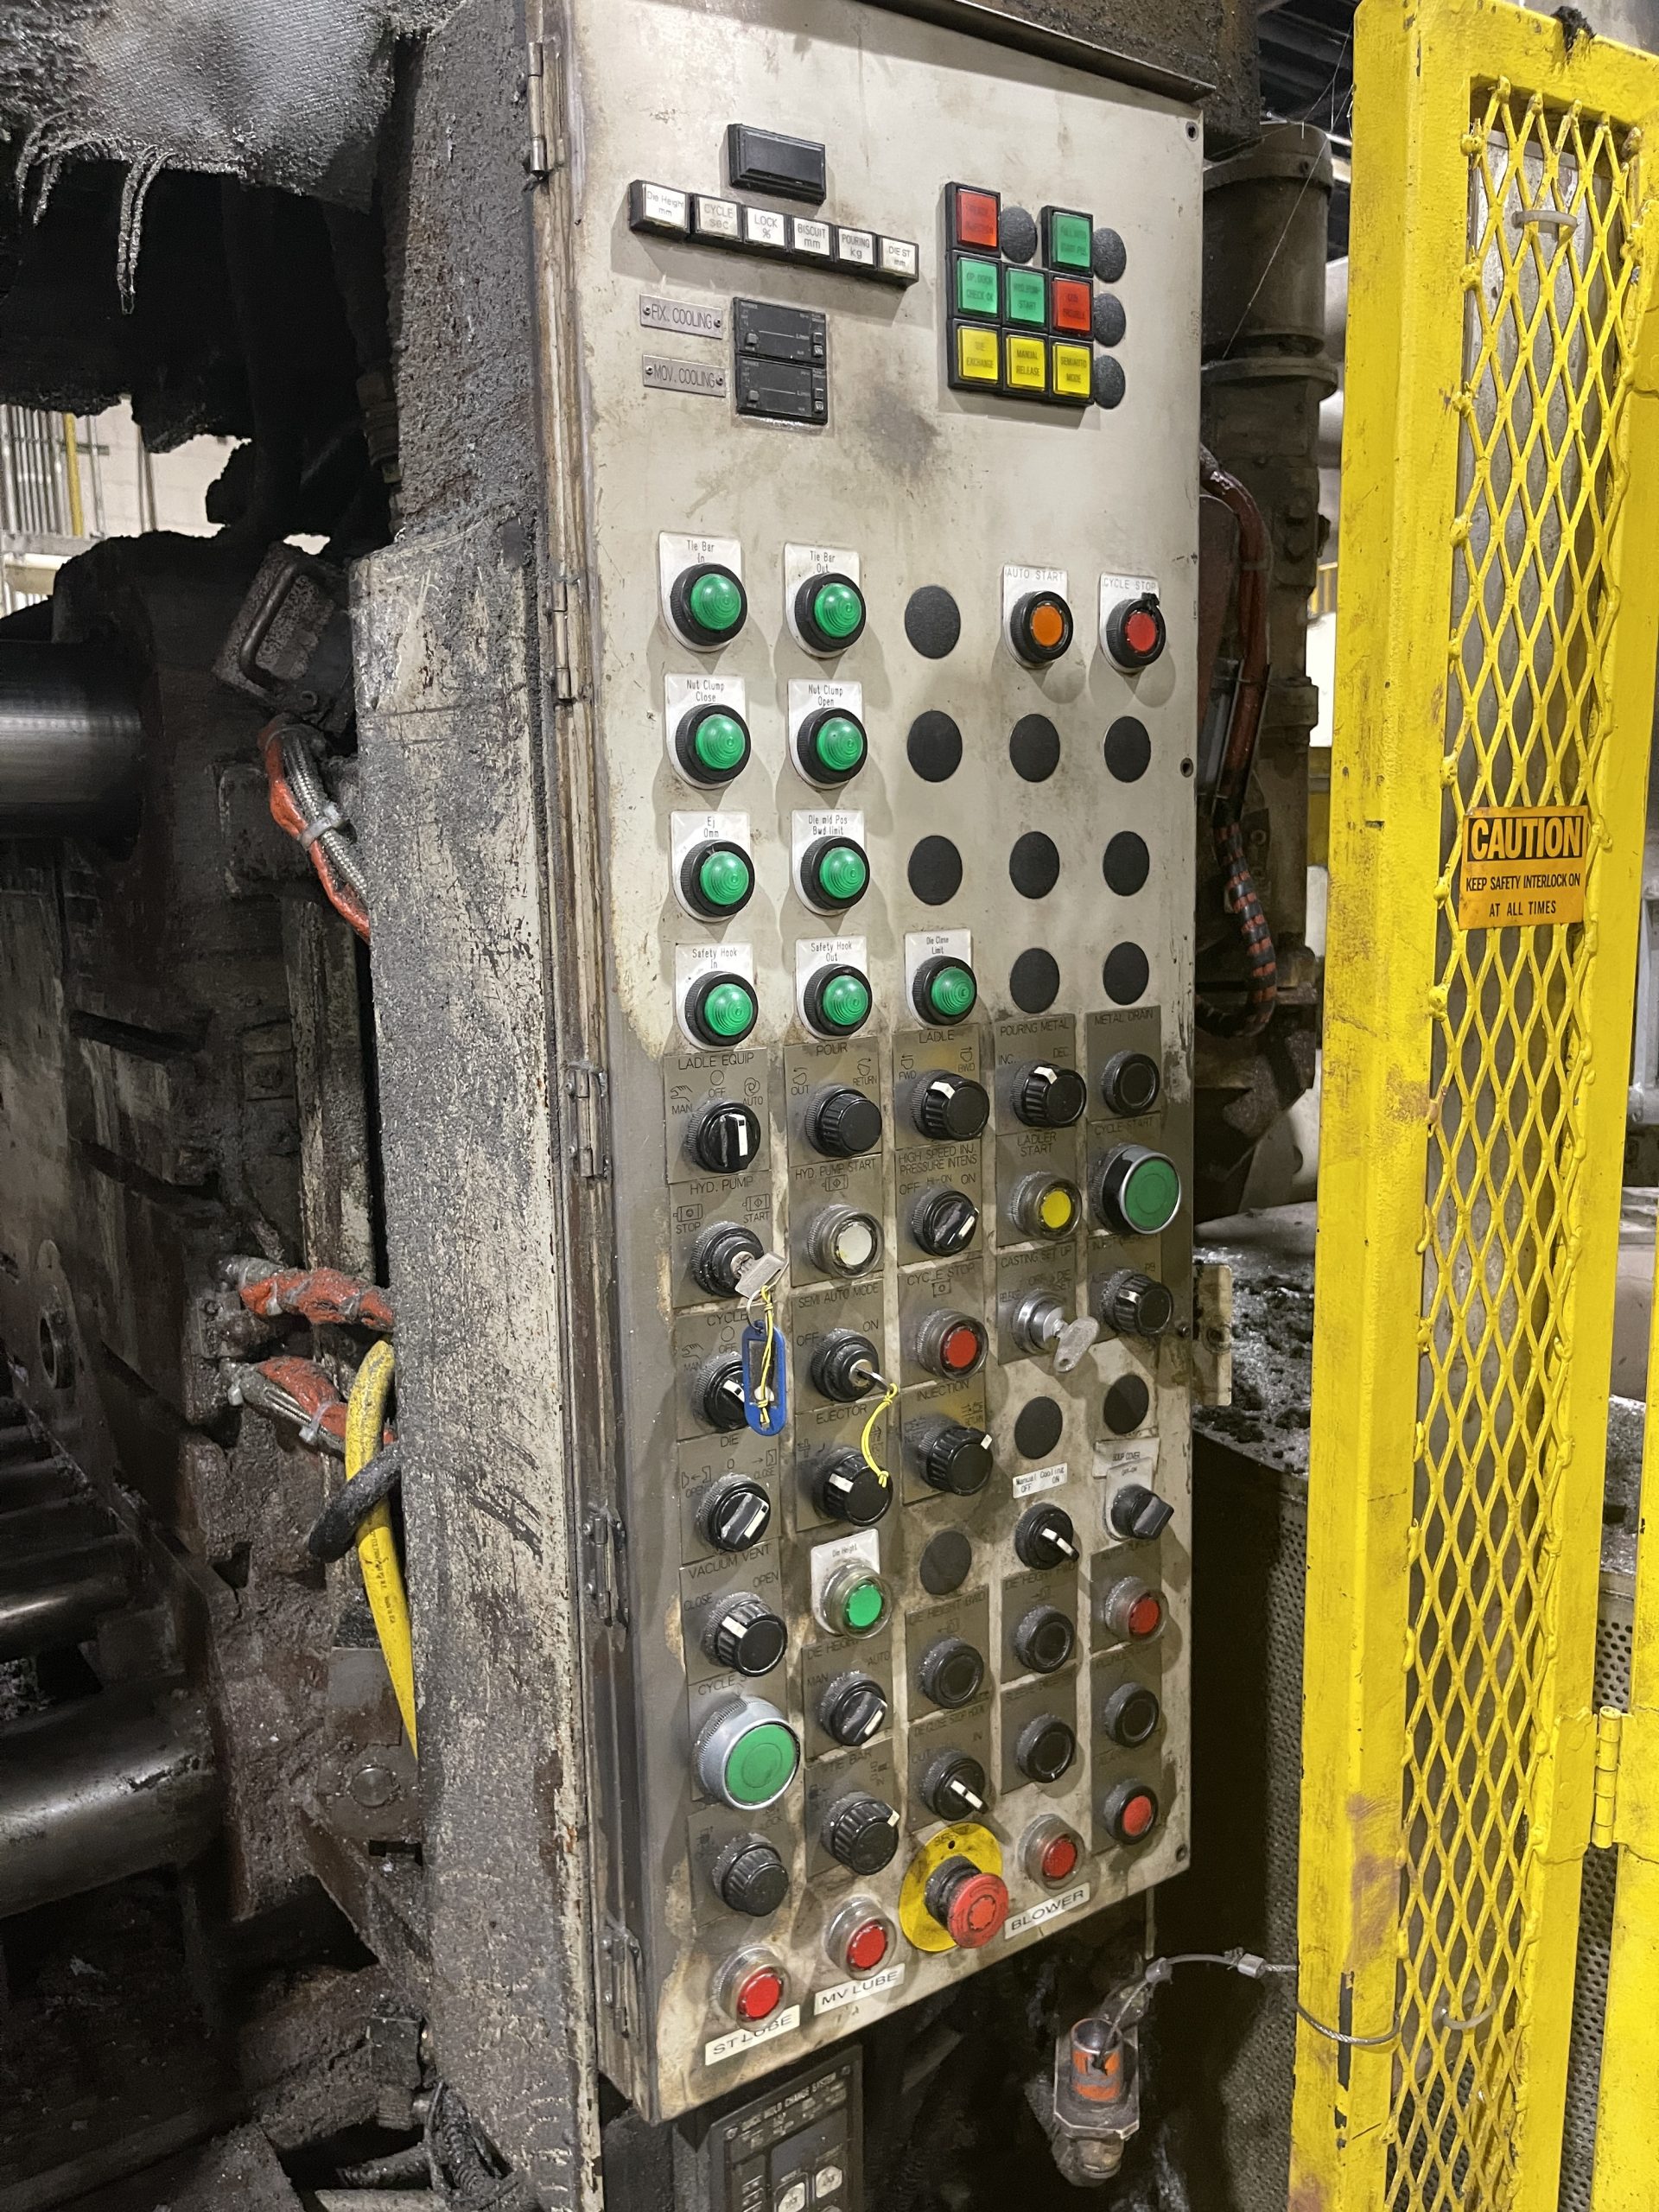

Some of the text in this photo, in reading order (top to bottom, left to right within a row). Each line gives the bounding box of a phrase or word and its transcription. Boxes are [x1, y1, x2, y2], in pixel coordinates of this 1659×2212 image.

[658, 207, 672, 216] mm
[704, 203, 734, 218] CYCLE
[709, 219, 729, 230] sec
[754, 213, 779, 228] LOCK
[762, 227, 772, 239] %
[798, 223, 826, 238] BISCUIT
[804, 238, 821, 249] mm
[842, 233, 870, 249] POURING
[850, 248, 863, 259] kg
[888, 245, 912, 258] DIE ST
[652, 303, 713, 330] FIX. COOLING
[1016, 349, 1038, 360] MANUAL
[654, 364, 715, 389] MOV. COOLING
[1016, 365, 1040, 378] RELEASE
[687, 539, 715, 553] Tie Bar
[810, 550, 836, 563] Tie Bar
[817, 563, 830, 574] Out
[1006, 567, 1064, 582] AUTO START
[1103, 577, 1156, 592] CYCLE STOP
[686, 679, 725, 692] Nut Clump
[808, 684, 843, 696] Nut Clump
[696, 691, 716, 702] Close
[817, 696, 835, 707] Open
[707, 817, 715, 829] Ej
[808, 815, 848, 825] Die mid Pos
[812, 826, 843, 836] Bwd limit
[1471, 817, 1582, 861] CAUTION
[1466, 873, 1581, 892] KEEP SAFETY INTERLOCK ON
[1489, 899, 1557, 918] AT ALL TIMES
[692, 947, 737, 959] Safety Hook
[810, 941, 852, 953] Safety Hook
[710, 959, 718, 969] In
[825, 952, 838, 962] Out
[1094, 1009, 1154, 1026] METAL DRAIN
[1000, 1018, 1071, 1037] POURING METAL
[918, 1029, 955, 1044] LADLE
[816, 1042, 849, 1056] POUR
[678, 1052, 754, 1070] LADLE EQUIP
[957, 1062, 976, 1072] BWD
[852, 1075, 878, 1086] RETURN
[899, 1071, 917, 1080] FWD
[709, 1087, 726, 1098] OFF
[791, 1085, 809, 1096] OUT
[743, 1096, 764, 1107] AUTO
[671, 1104, 693, 1116] MAN
[1094, 1122, 1122, 1136] CYCLE
[1017, 1131, 1057, 1147] LADLER
[898, 1151, 922, 1164] HIGH
[925, 1147, 957, 1160] SPEED
[1020, 1142, 1052, 1158] START
[820, 1163, 844, 1176] PUMP
[848, 1158, 877, 1173] START
[899, 1154, 978, 1175] PRESSURE INTENS
[690, 1175, 754, 1196] HYD. PUMP
[961, 1173, 977, 1185] ON
[899, 1181, 920, 1195] OFF
[743, 1211, 770, 1224] START
[676, 1221, 702, 1235] STOP
[1001, 1253, 1038, 1268] CASTING
[1059, 1244, 1072, 1257] UP
[907, 1262, 976, 1286] CYCLE STOP
[798, 1282, 879, 1308] SEMI AUTO MODE
[707, 1309, 747, 1326] CYCLE
[862, 1319, 880, 1332] ON
[796, 1332, 820, 1346] OFF
[718, 1342, 737, 1354] OFF
[816, 1403, 868, 1424] EJECTOR
[720, 1433, 740, 1447] DIE
[1015, 1466, 1065, 1486] Manual Cooling
[1052, 1475, 1059, 1484] ON
[1020, 1483, 1033, 1493] OFF
[688, 1544, 771, 1580] VACUUM VENT
[753, 1570, 779, 1588] OPEN
[683, 1592, 713, 1611] CLOSE
[867, 1650, 891, 1666] AUTO
[698, 1674, 735, 1695] CYCLE
[1010, 1889, 1085, 1931] BLOWER
[821, 1968, 899, 2005] MV LUBE
[713, 2013, 793, 2055] ST LUBE
